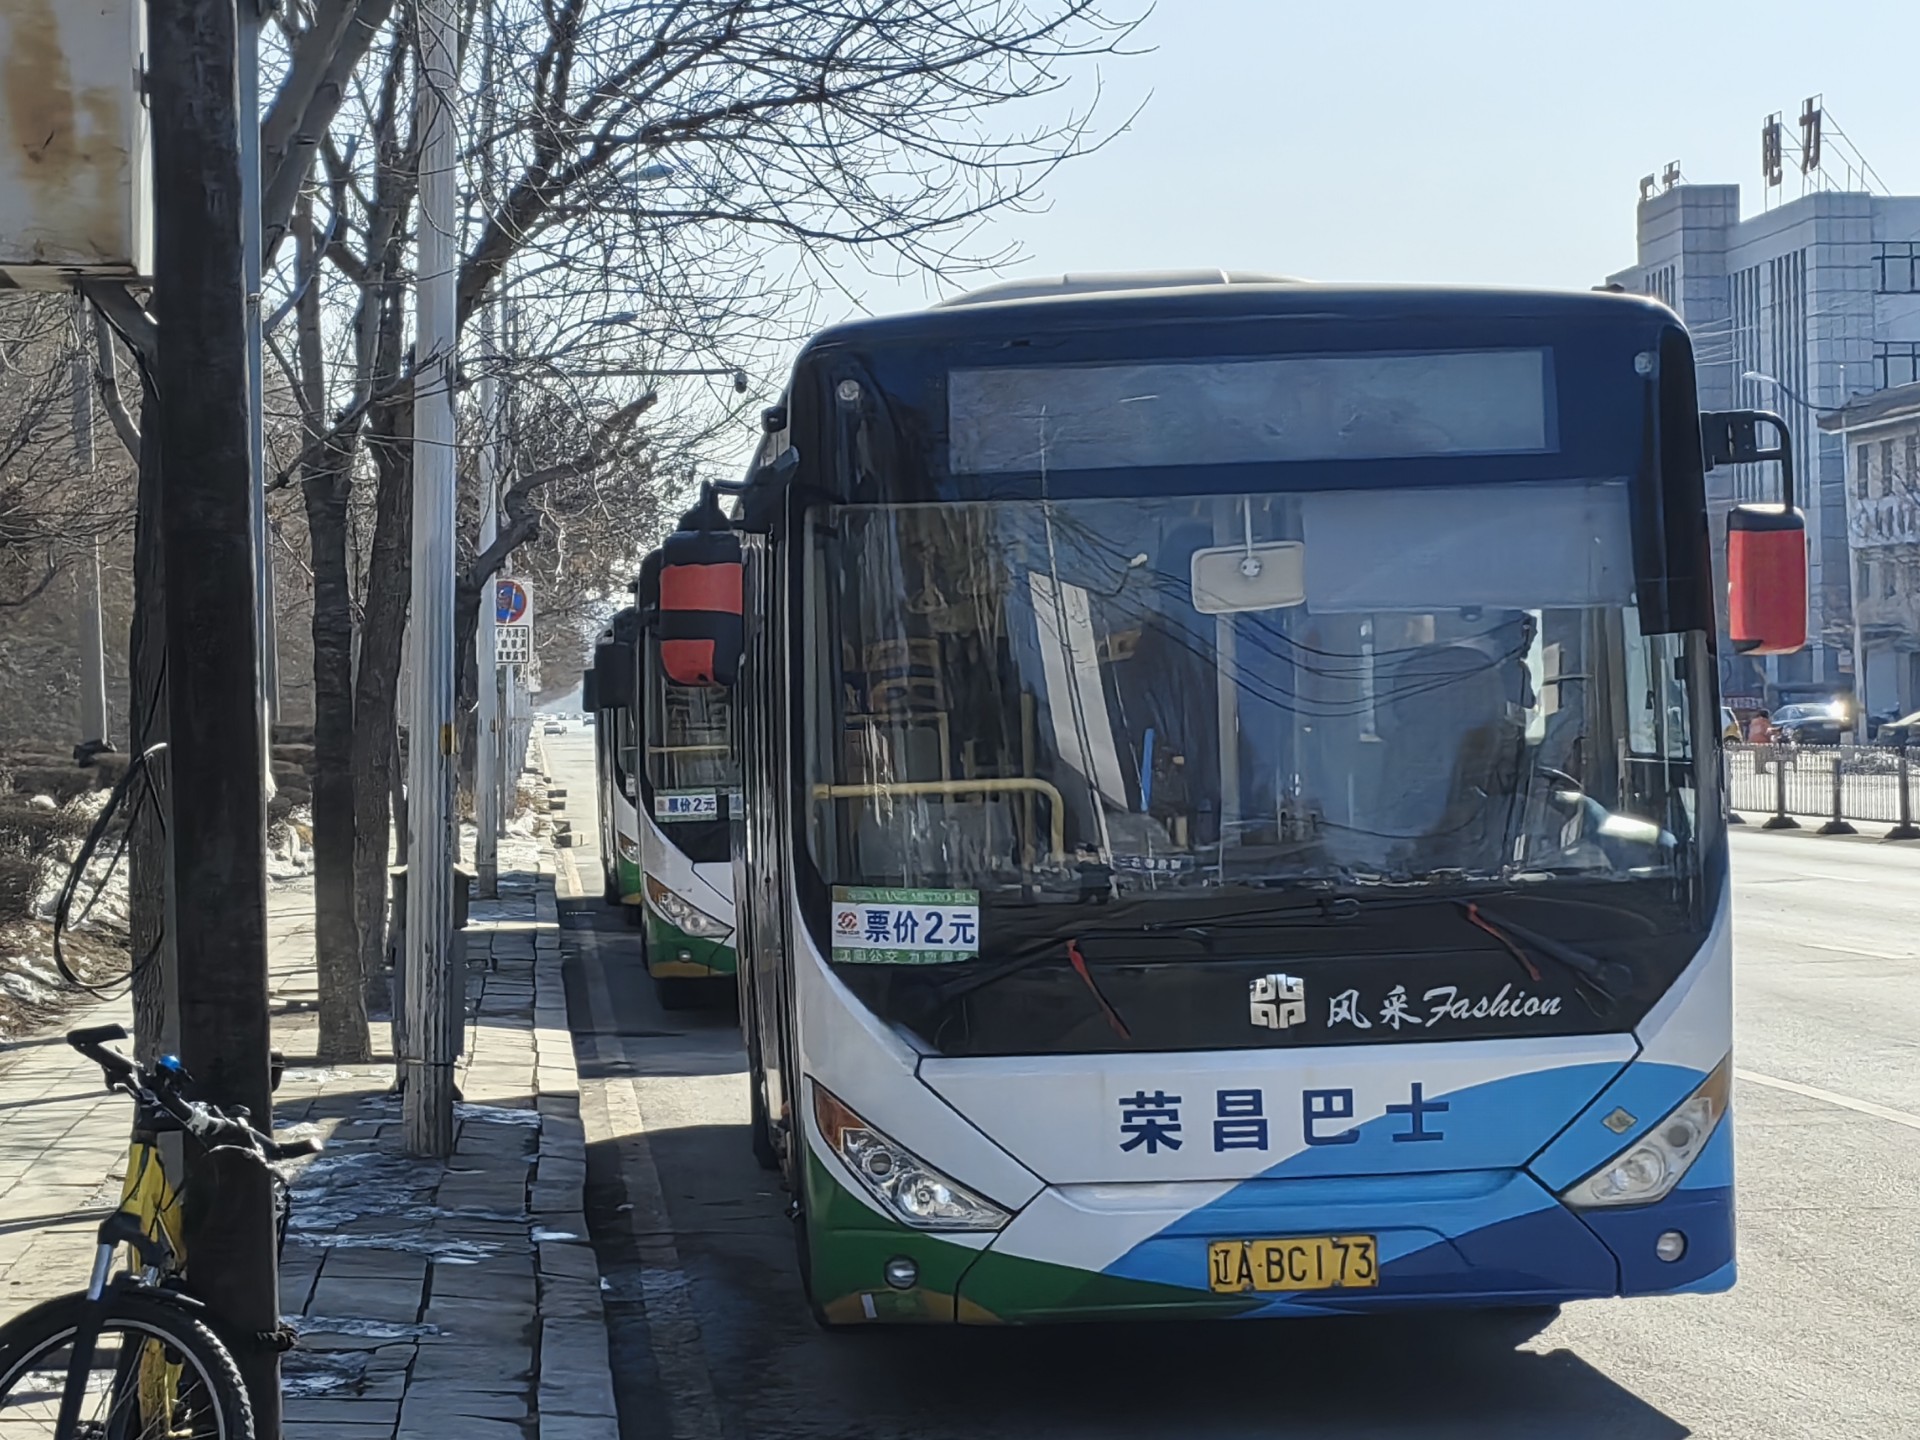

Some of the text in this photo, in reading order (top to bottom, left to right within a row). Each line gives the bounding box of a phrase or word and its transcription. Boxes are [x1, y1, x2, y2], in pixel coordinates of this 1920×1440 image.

[1762, 97, 1823, 187] 电力
[865, 909, 976, 944] 票价2元
[1326, 983, 1562, 1031] 风采 Fashion
[1118, 1082, 1450, 1154] 荣昌巴士
